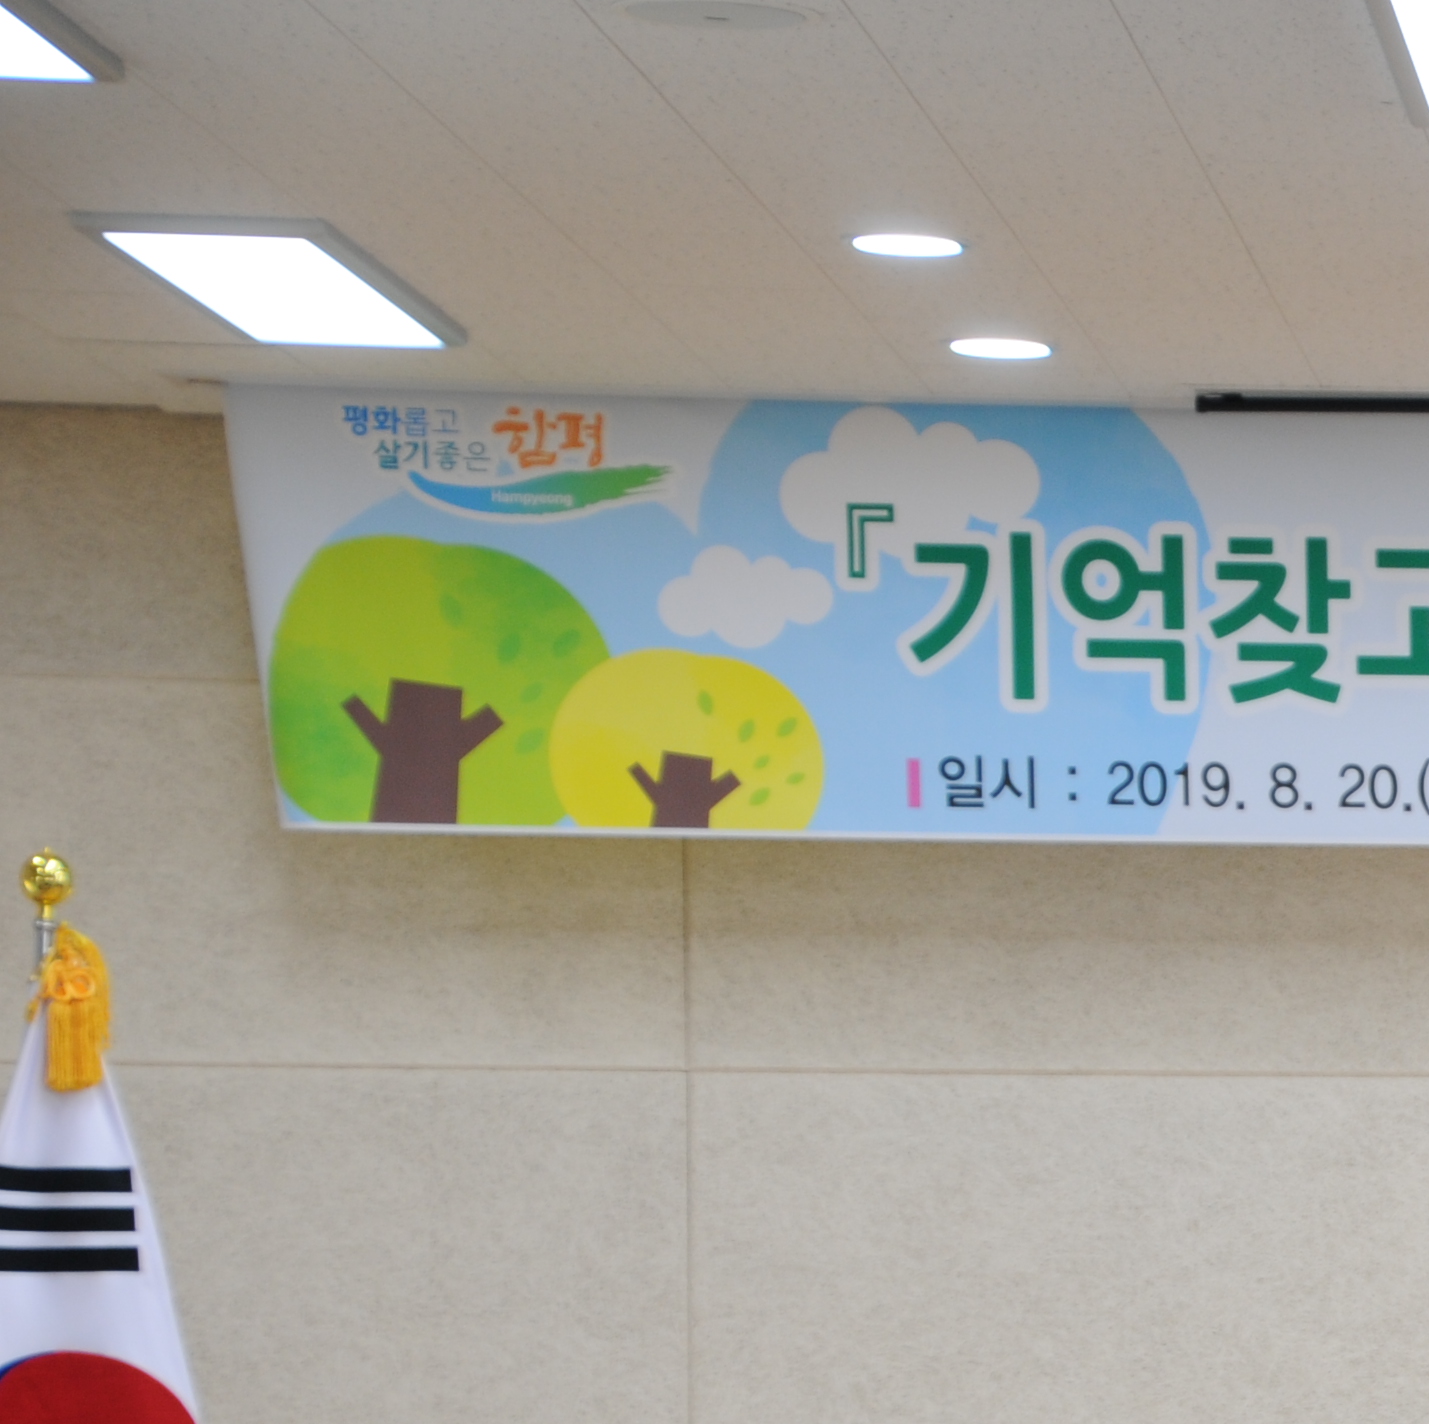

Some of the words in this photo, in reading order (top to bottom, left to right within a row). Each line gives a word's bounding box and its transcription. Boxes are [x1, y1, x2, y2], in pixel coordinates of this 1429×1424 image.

[342, 404, 460, 437] 평화롭고
[492, 406, 606, 470] 함평
[491, 488, 575, 507] Hampyeong
[937, 754, 1037, 810] 일시
